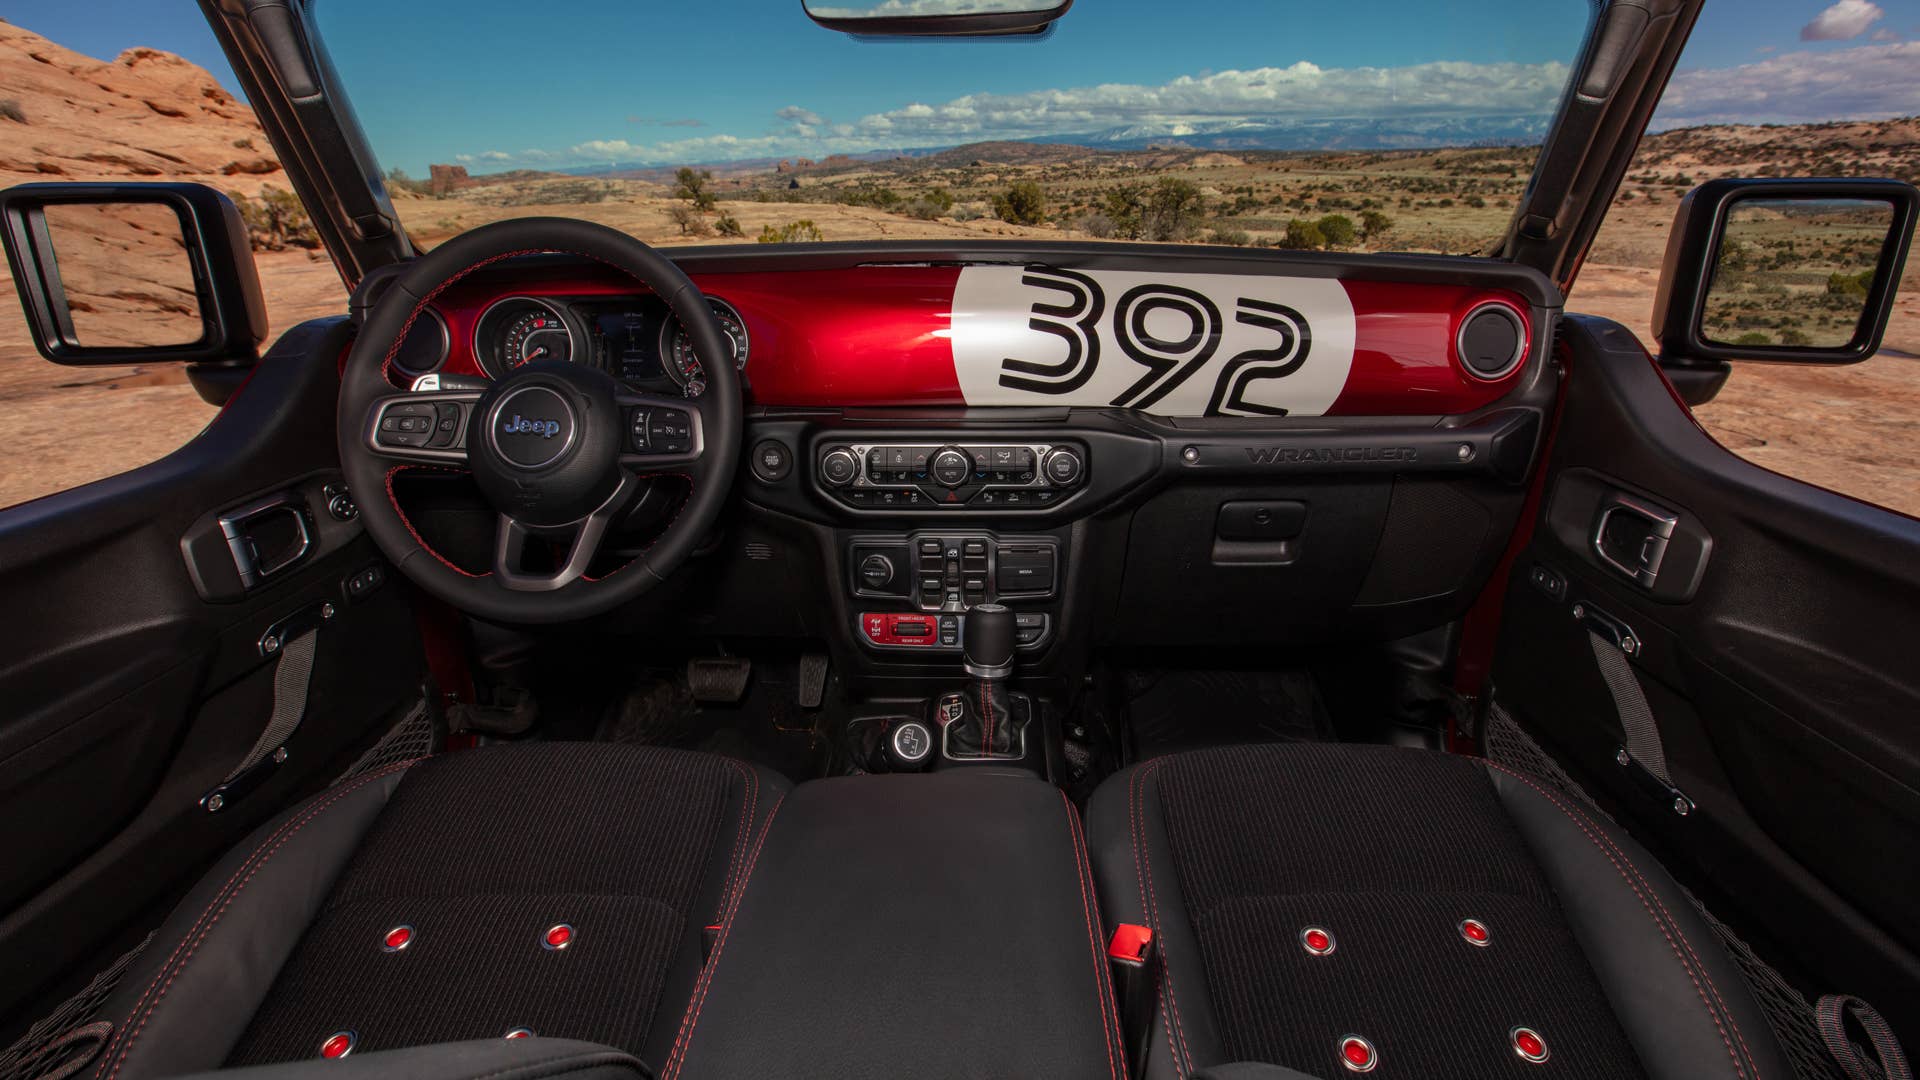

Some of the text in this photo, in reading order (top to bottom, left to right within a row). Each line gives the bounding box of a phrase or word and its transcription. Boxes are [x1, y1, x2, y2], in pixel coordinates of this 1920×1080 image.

[998, 265, 1312, 417] 392
[504, 415, 560, 438] Jeep
[1244, 447, 1417, 464] WRANGLER
